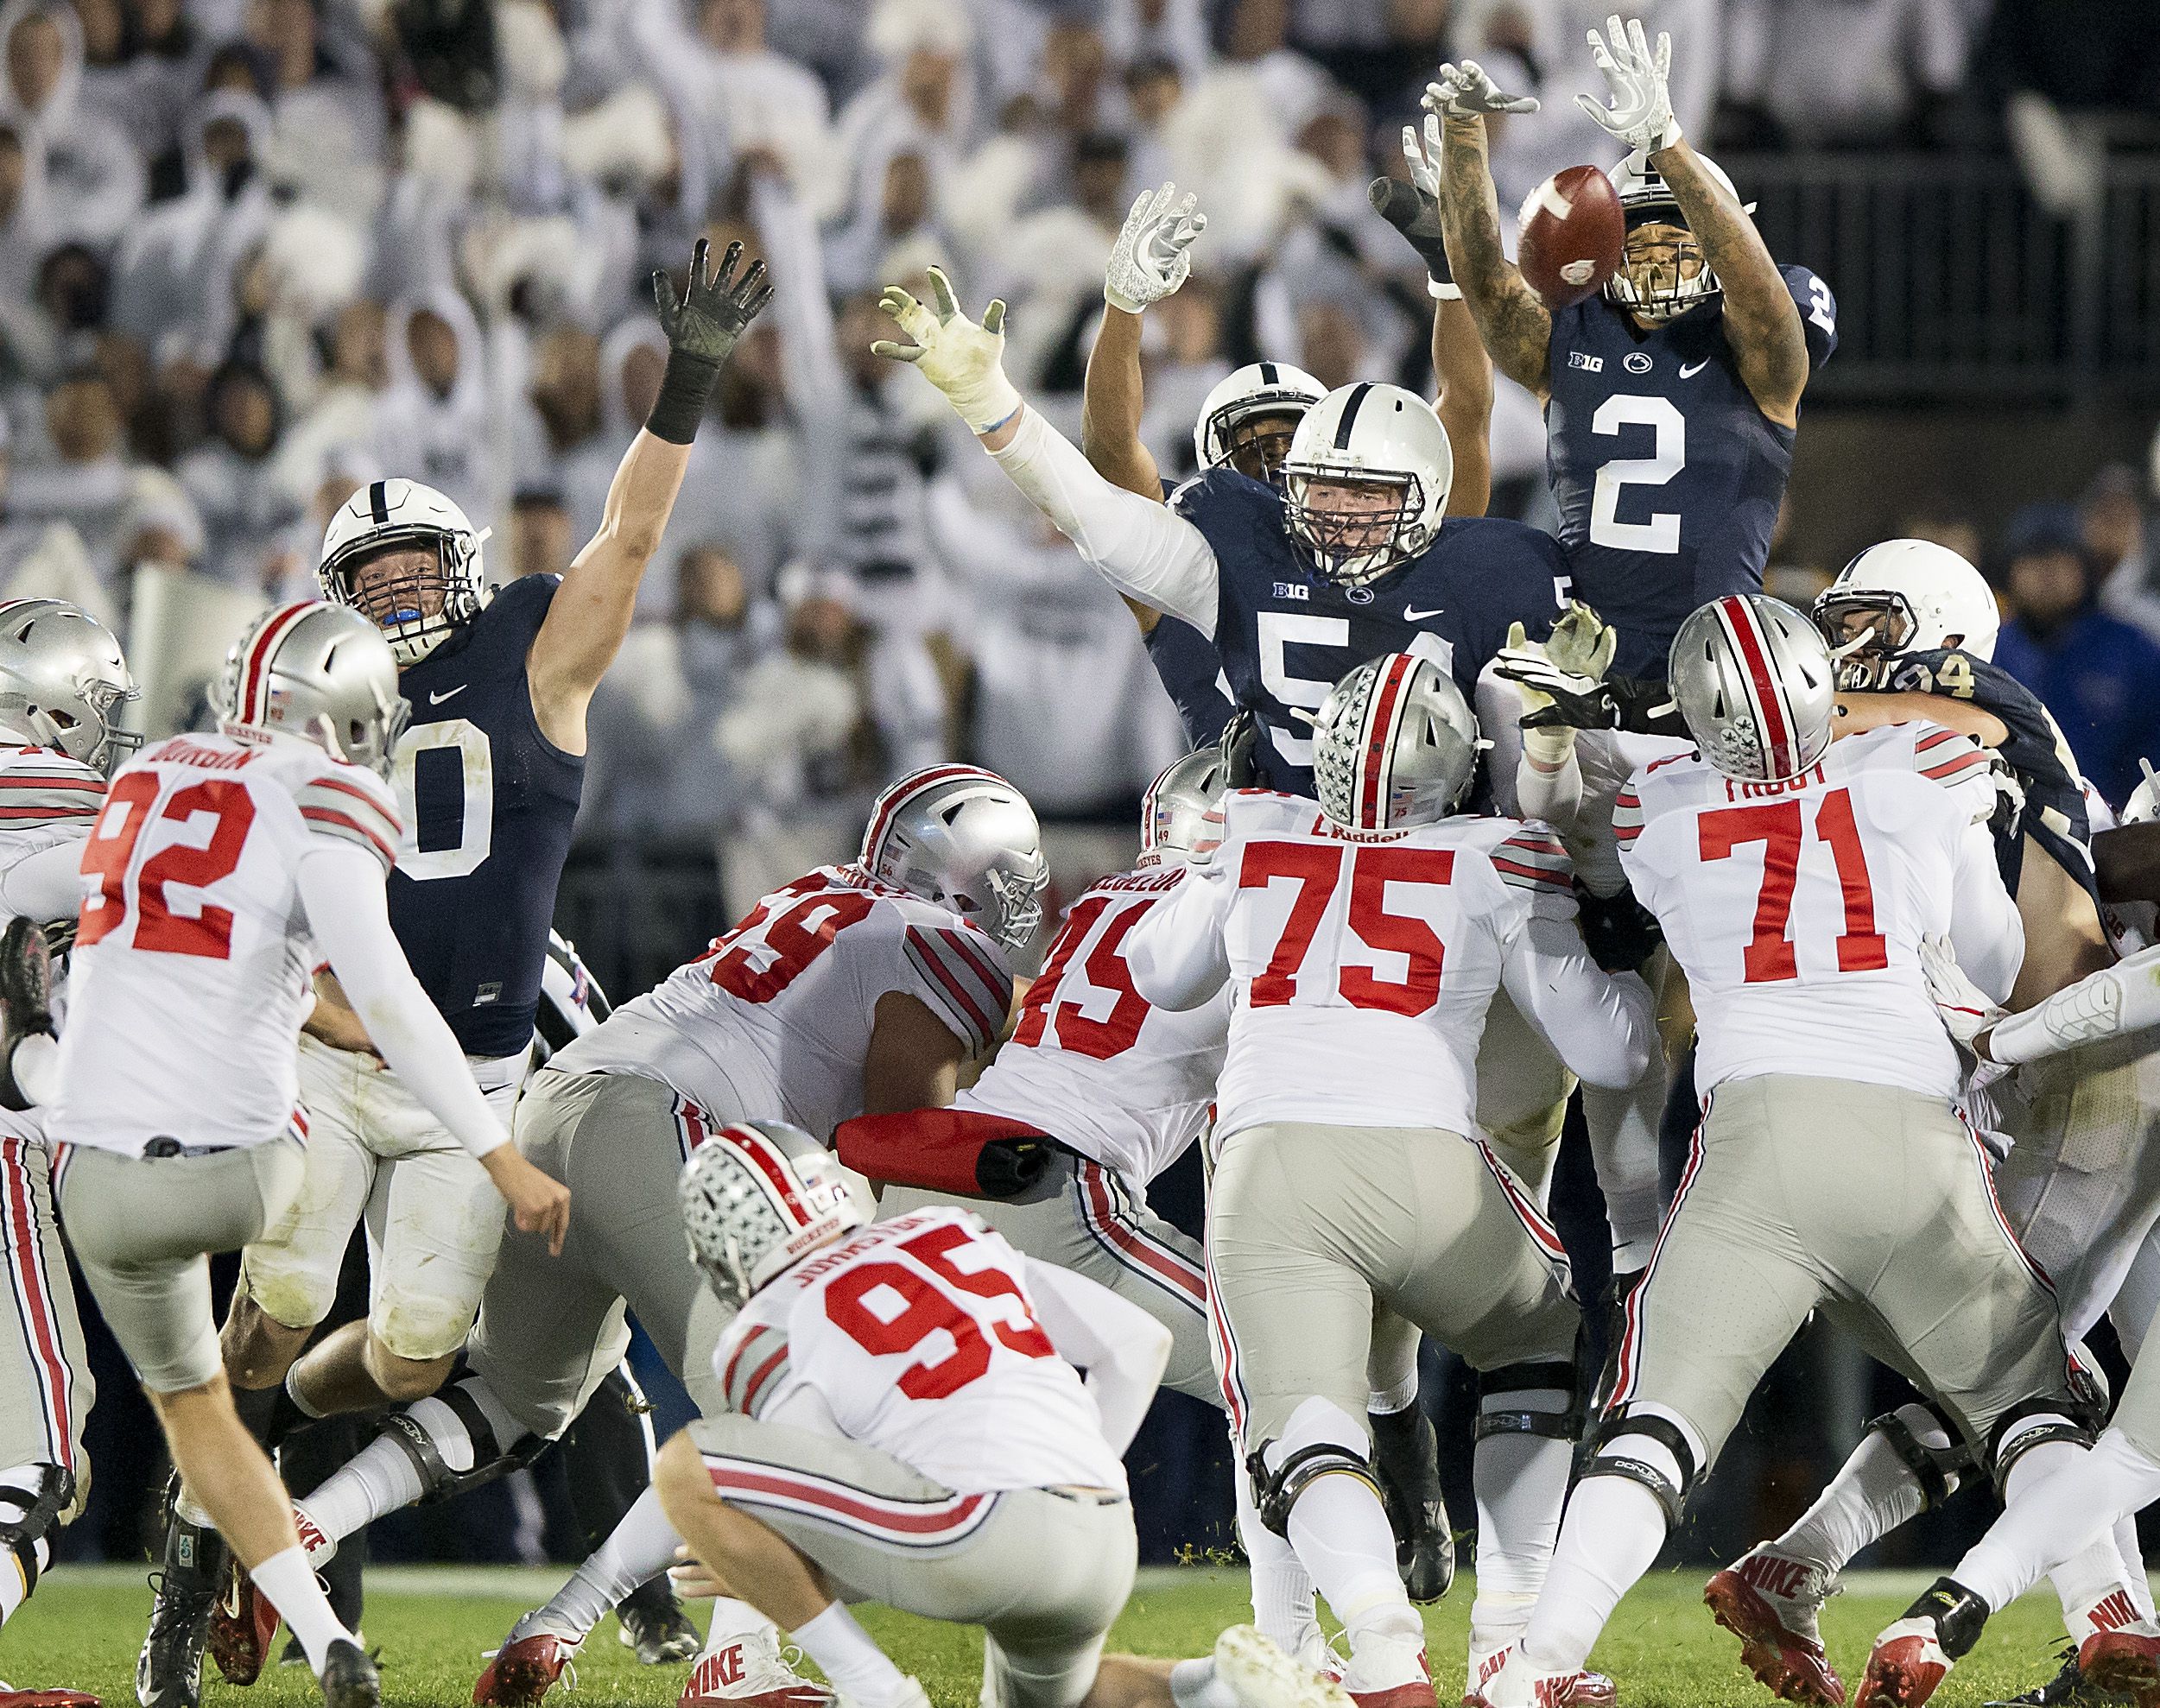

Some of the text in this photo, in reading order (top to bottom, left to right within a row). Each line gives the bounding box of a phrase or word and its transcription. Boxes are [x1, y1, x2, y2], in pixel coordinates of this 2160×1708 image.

[1808, 275, 1836, 336] 2
[1568, 351, 1604, 372] BIG
[1590, 394, 1685, 554] 2
[1273, 582, 1309, 600] BIG
[1333, 824, 1409, 843] Riddell
[1394, 807, 1408, 818] 75
[1158, 830, 1169, 841] 49
[75, 771, 257, 959] 92
[1697, 787, 1889, 983] 71
[1238, 841, 1455, 1017] 75
[824, 1224, 1056, 1400] 95
[2009, 1426, 2058, 1448] DONJOY
[1615, 1460, 1666, 1485] DONJOY
[1739, 1555, 1813, 1600] NIKE
[685, 1643, 745, 1698] NIKE
